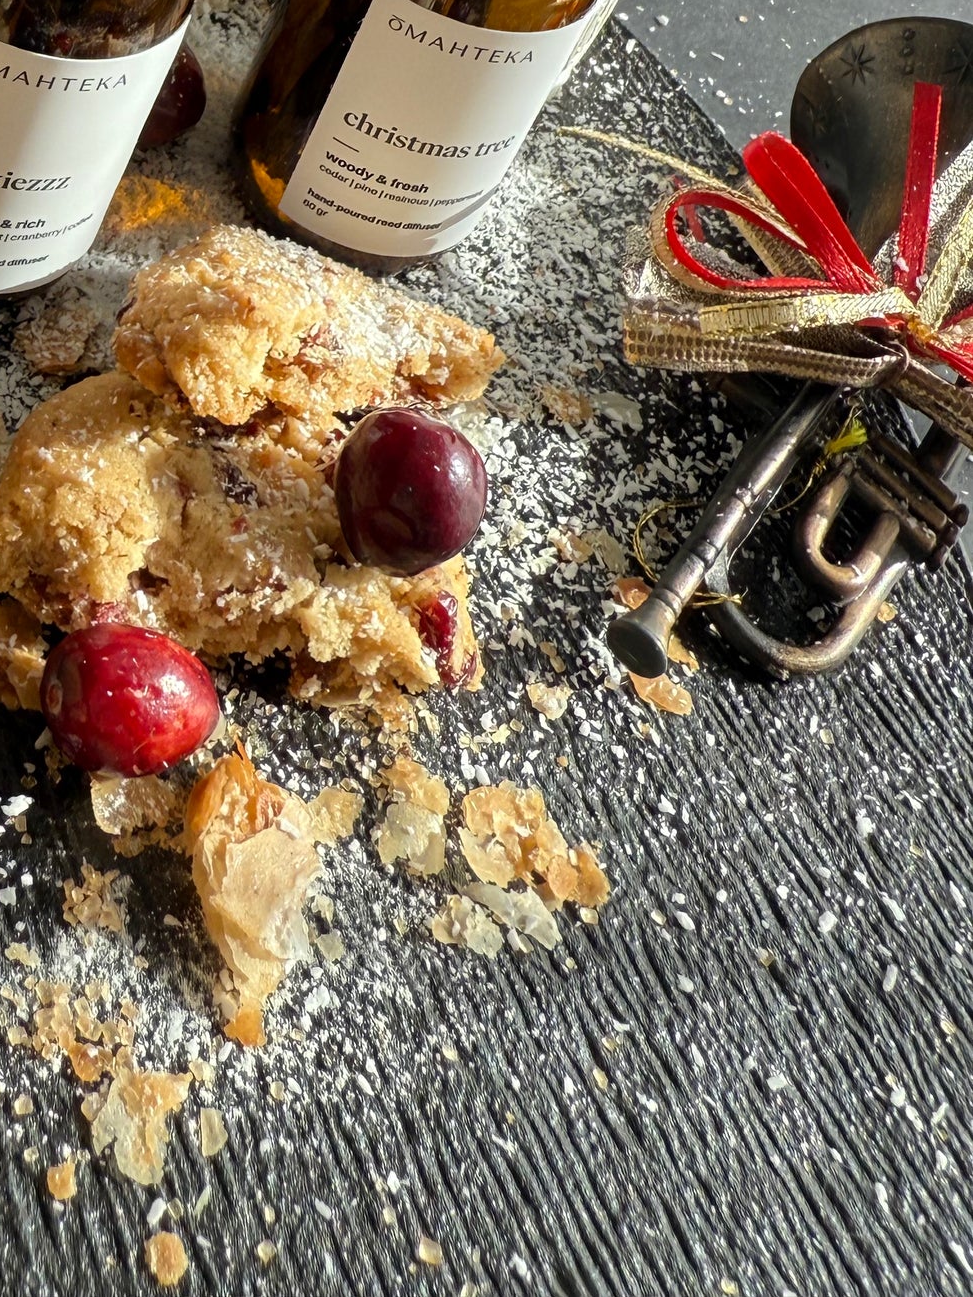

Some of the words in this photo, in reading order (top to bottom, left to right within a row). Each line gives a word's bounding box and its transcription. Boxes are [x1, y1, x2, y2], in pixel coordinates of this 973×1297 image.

[343, 111, 471, 159] christmas
[474, 136, 515, 157] tree
[326, 151, 374, 181] woody
[375, 174, 387, 185] &
[390, 178, 429, 193] fresh
[0, 219, 12, 229] &
[15, 218, 46, 229] rich
[307, 187, 376, 223] hand-poured
